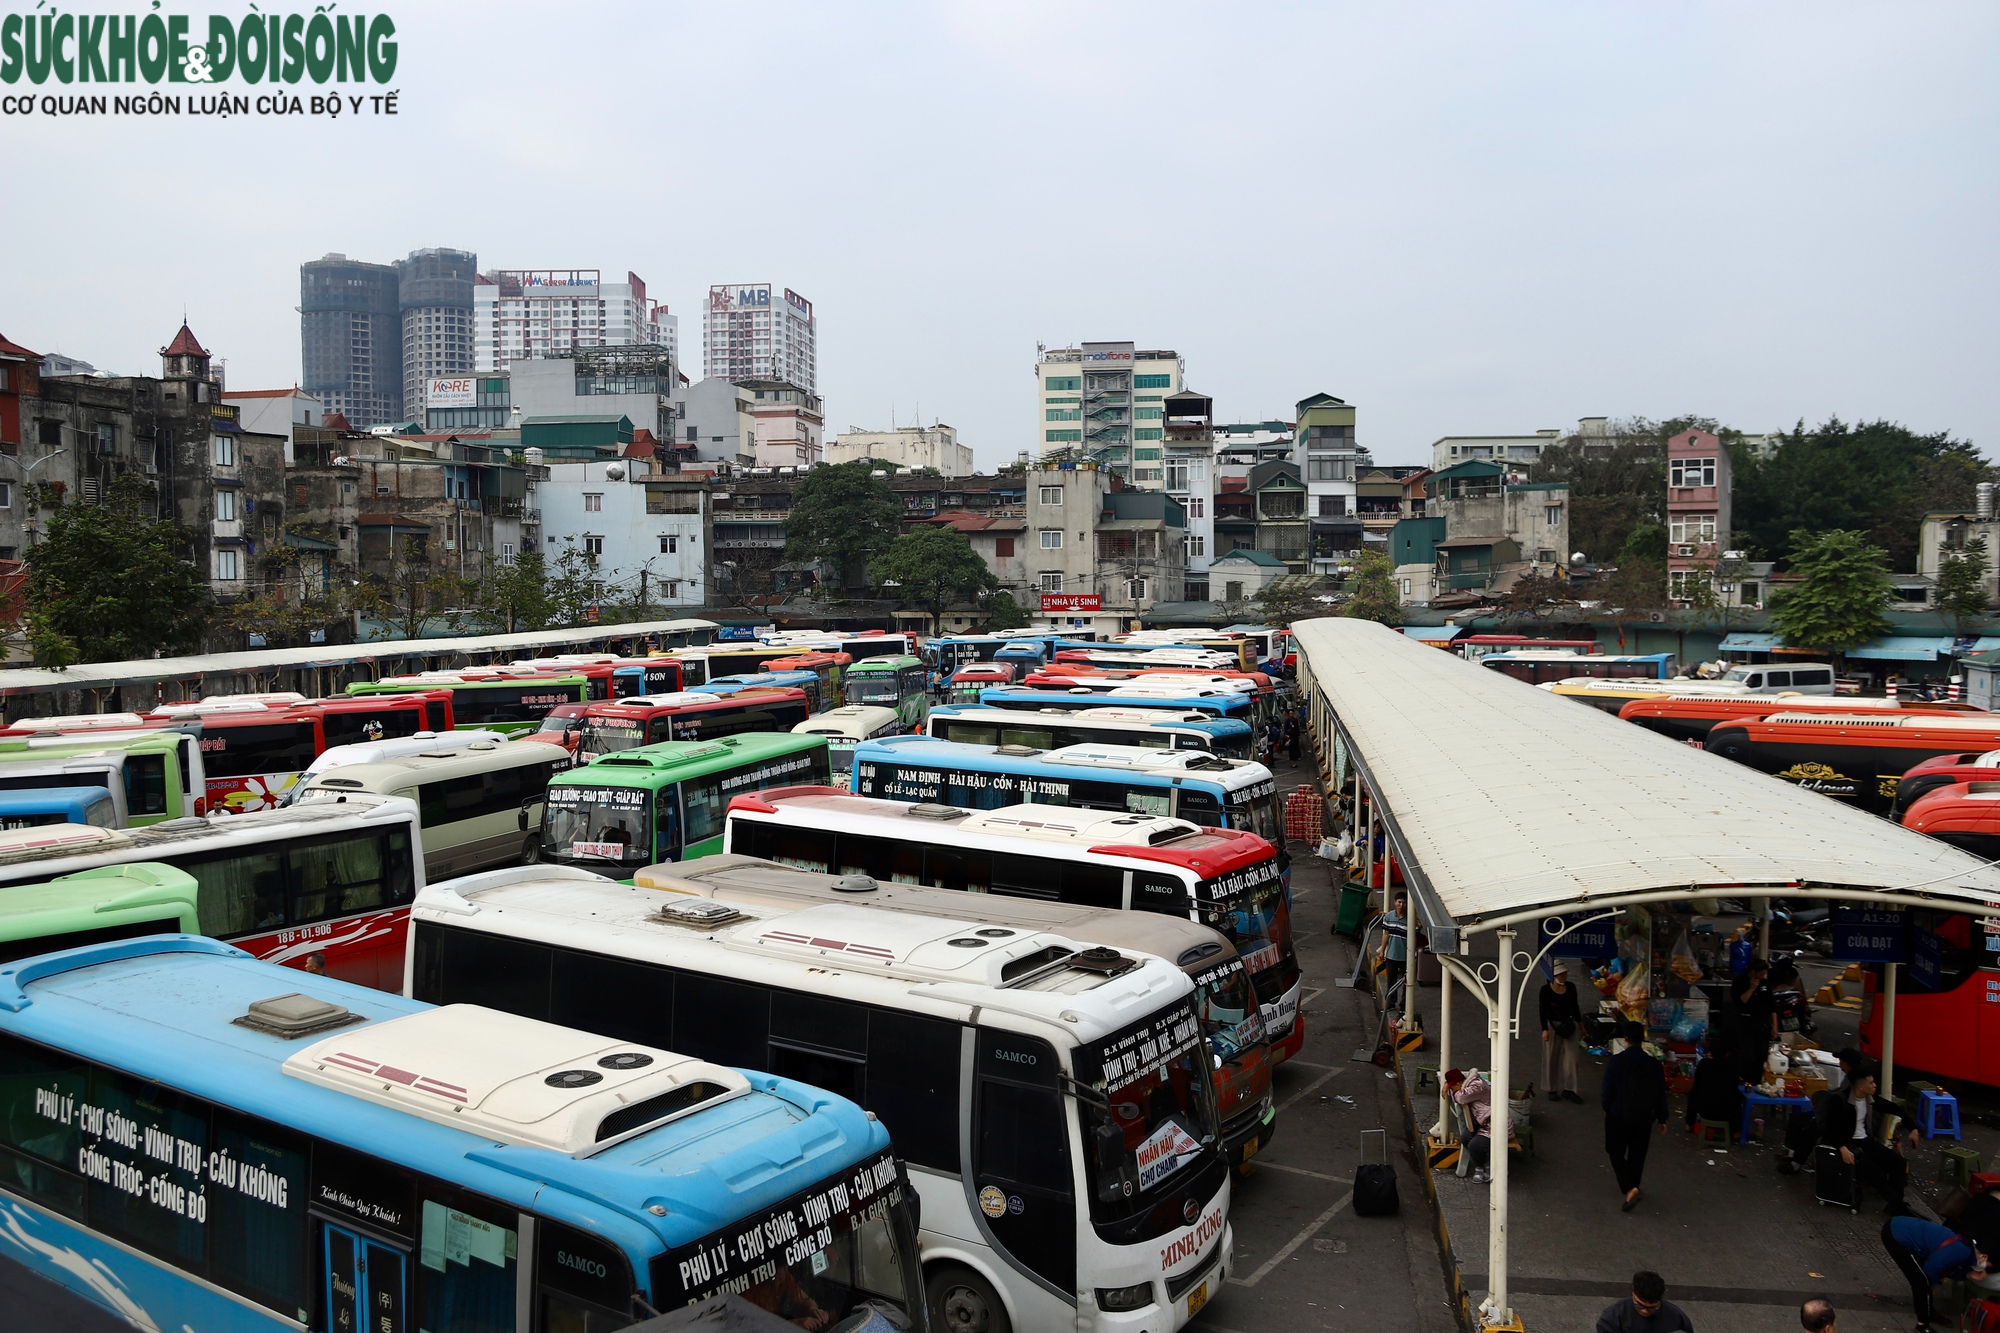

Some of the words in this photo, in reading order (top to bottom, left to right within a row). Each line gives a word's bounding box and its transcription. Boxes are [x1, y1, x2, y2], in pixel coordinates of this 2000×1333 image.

[739, 289, 769, 306] MB
[1083, 351, 1131, 361] mobifone
[1052, 596, 1068, 606] NHÀ
[1069, 596, 1079, 607] VỆ
[649, 672, 666, 682] SƠN
[213, 736, 226, 751] BÁT
[897, 769, 918, 783] NAM
[918, 770, 942, 785] ĐỊNH
[949, 773, 966, 788] HẢI
[966, 774, 987, 788] HẬU
[993, 774, 1012, 790] CỒN
[1020, 776, 1037, 793] HẢI
[1038, 782, 1070, 798] THỊNH
[905, 786, 918, 797] LẠC
[550, 789, 561, 801] GIAO
[632, 790, 644, 804] BÁT
[1186, 796, 1208, 805] SAMCO
[1232, 790, 1242, 804] HẢI
[602, 845, 612, 856] GIAO
[1145, 884, 1173, 894] SAMCO
[1210, 876, 1228, 900] HẢI
[1269, 859, 1280, 880] NỘI
[1862, 913, 1900, 924] A1-20
[1584, 934, 1606, 948] TRỤ
[1847, 932, 1871, 948] CỬA
[1872, 936, 1893, 951] ĐẠT
[1104, 1044, 1118, 1057] B.X
[1118, 1035, 1136, 1050] VĨNH
[1136, 1028, 1150, 1042] TRỤ
[1156, 1018, 1167, 1030] B.X
[1166, 1010, 1180, 1025] GIÁP
[1180, 1005, 1190, 1018] BÁT
[995, 1049, 1037, 1066] SAMCO
[1102, 1058, 1124, 1083] VĨNH
[1122, 1050, 1138, 1074] TRỤ
[1174, 1020, 1190, 1044] NHÂN
[1108, 1082, 1118, 1094] PHỦ
[36, 1082, 58, 1120] PHỦ
[60, 1092, 74, 1126] LÝ
[80, 1103, 105, 1142] CHỢ
[106, 1110, 137, 1150] SÔNG
[144, 1124, 174, 1164] VĨNH
[177, 1138, 202, 1180] TRỤ
[209, 1148, 236, 1188] CẦU
[240, 1163, 288, 1208] KHÔNG
[1138, 1139, 1160, 1168] NHÂN
[1160, 1134, 1174, 1156] HẬU
[1140, 1166, 1155, 1186] CHỢ
[1156, 1154, 1178, 1178] CHANH
[79, 1144, 110, 1184] CỐNG
[114, 1160, 144, 1198] TRÓC
[150, 1172, 184, 1216] CỐNG
[188, 1184, 206, 1224] ĐỎ
[320, 1185, 338, 1202] Kính
[338, 1192, 356, 1210] Chào
[356, 1198, 371, 1216] Quý
[372, 1204, 396, 1224] Khách
[851, 1209, 868, 1232] B.X
[868, 1195, 888, 1219] GIÁP
[888, 1185, 902, 1208] BÁT
[679, 1244, 711, 1291] PHỦ
[712, 1237, 728, 1276] LÝ
[738, 1228, 766, 1264] CHỢ
[764, 1210, 800, 1250] SÔNG
[802, 1194, 828, 1229] VĨNH
[828, 1182, 851, 1214] TRỤ
[872, 1154, 898, 1191] KHÔNG
[784, 1234, 816, 1267] CỐNG
[816, 1220, 834, 1250] ĐỎ
[1160, 1232, 1196, 1272] MINH
[1196, 1208, 1222, 1247] TÙNG
[558, 1250, 606, 1278] SAMCO
[752, 1259, 778, 1282] TRỤ
